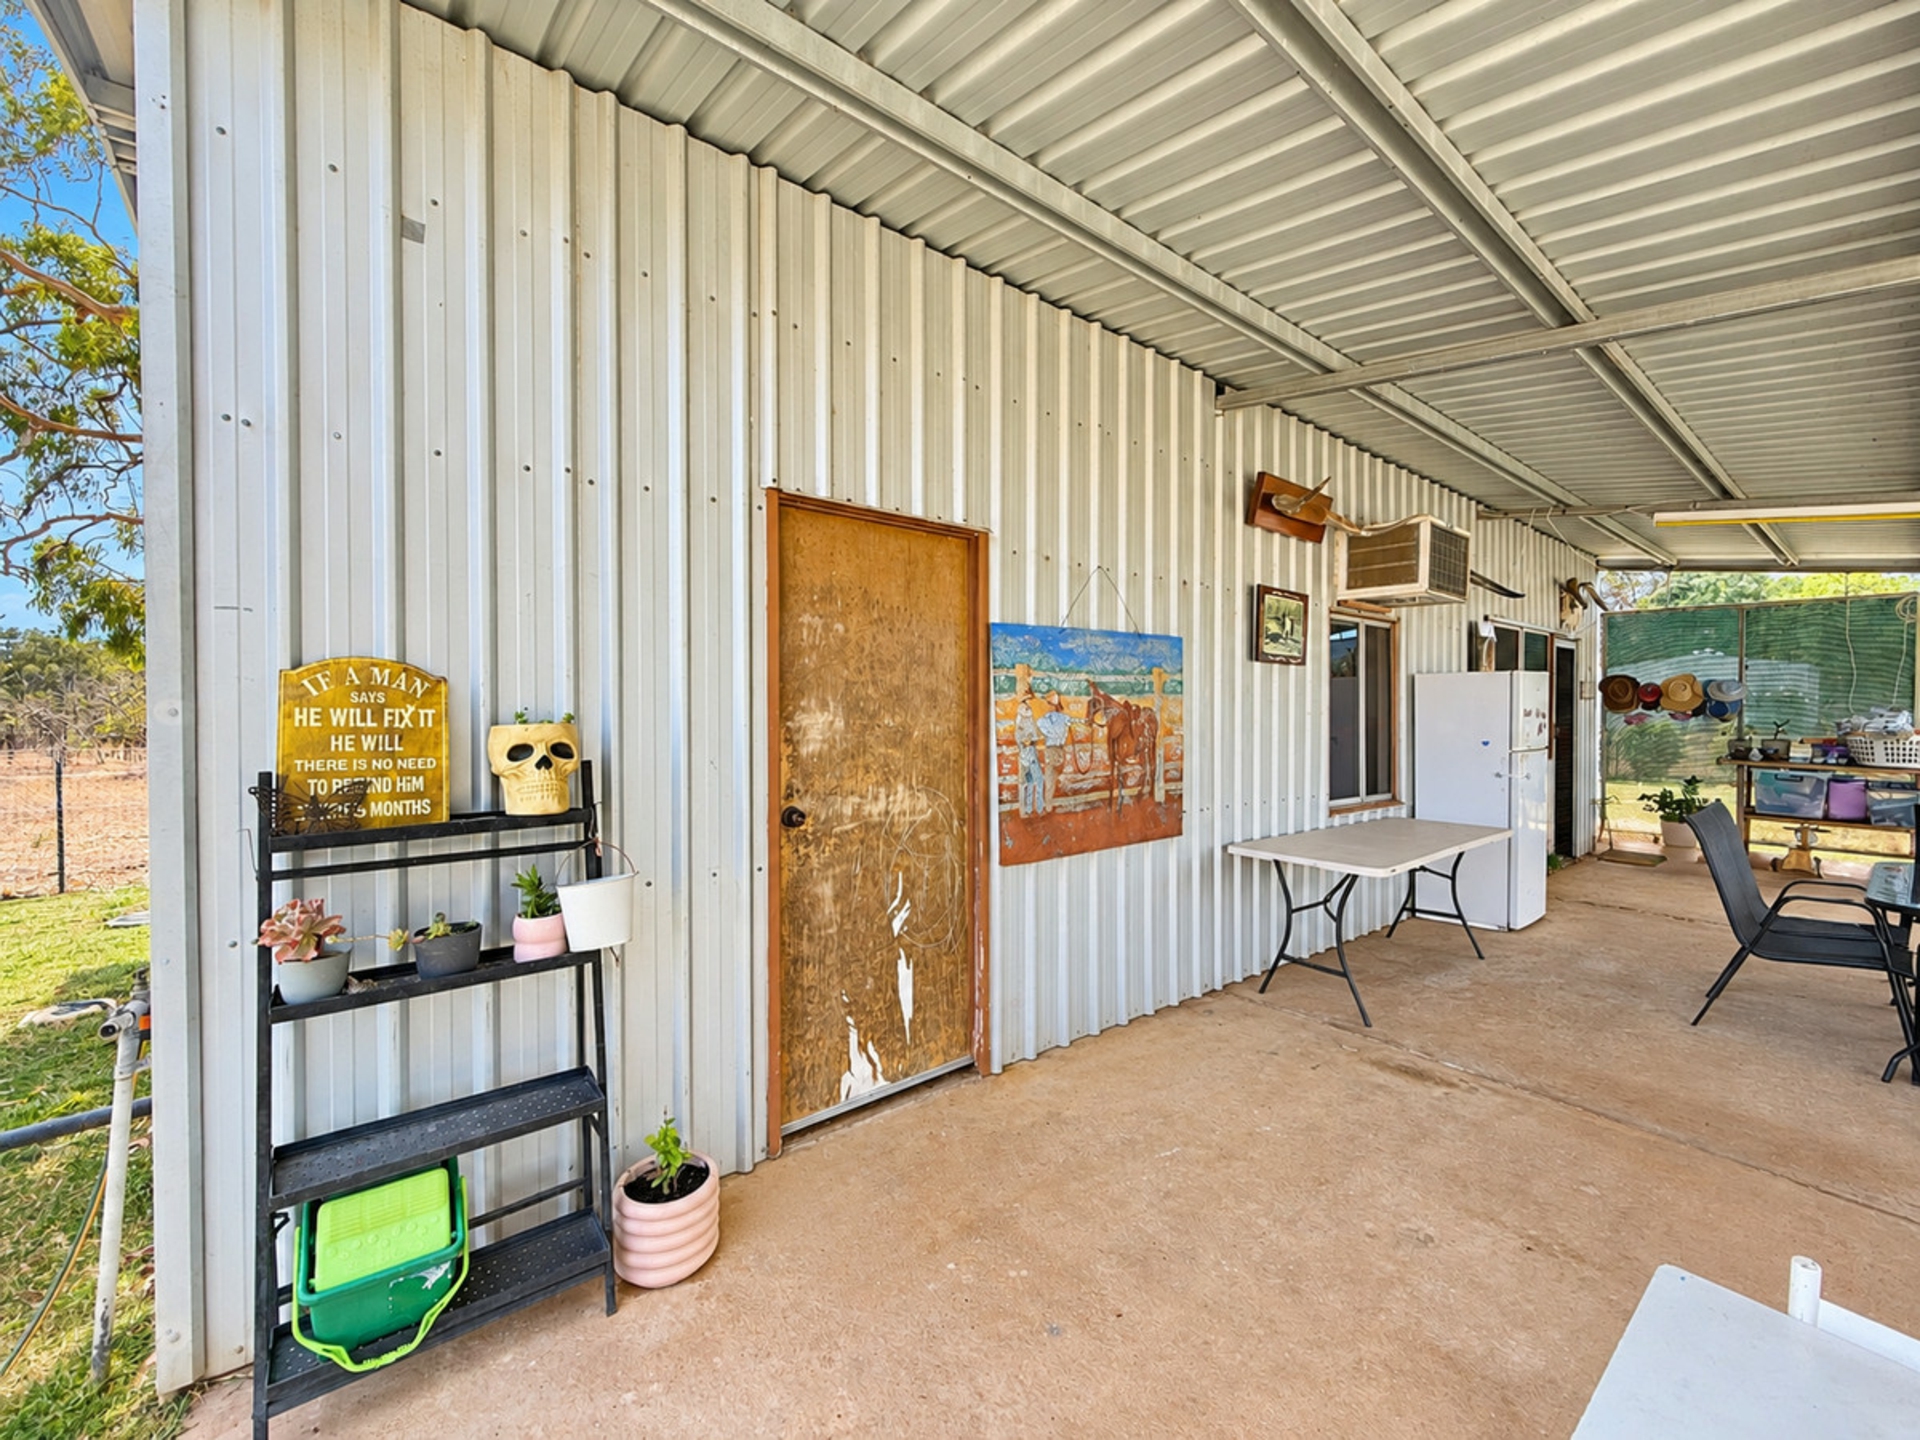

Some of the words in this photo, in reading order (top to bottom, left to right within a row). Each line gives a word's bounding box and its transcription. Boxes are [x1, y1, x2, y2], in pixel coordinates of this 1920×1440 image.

[301, 670, 334, 697] IF
[345, 667, 361, 686] A
[370, 667, 431, 699] MAN
[350, 691, 386, 704] SAYS
[294, 707, 322, 727] HE
[330, 708, 378, 728] WILL
[384, 704, 416, 729] FIX
[419, 709, 436, 728] IT
[330, 735, 356, 752] HE
[361, 735, 404, 752] WILL
[294, 759, 348, 772] THERE
[353, 759, 368, 771] IS
[371, 759, 393, 771] NO
[397, 757, 437, 770] NEED
[307, 778, 328, 796] TO
[370, 798, 431, 818] MONTHS
